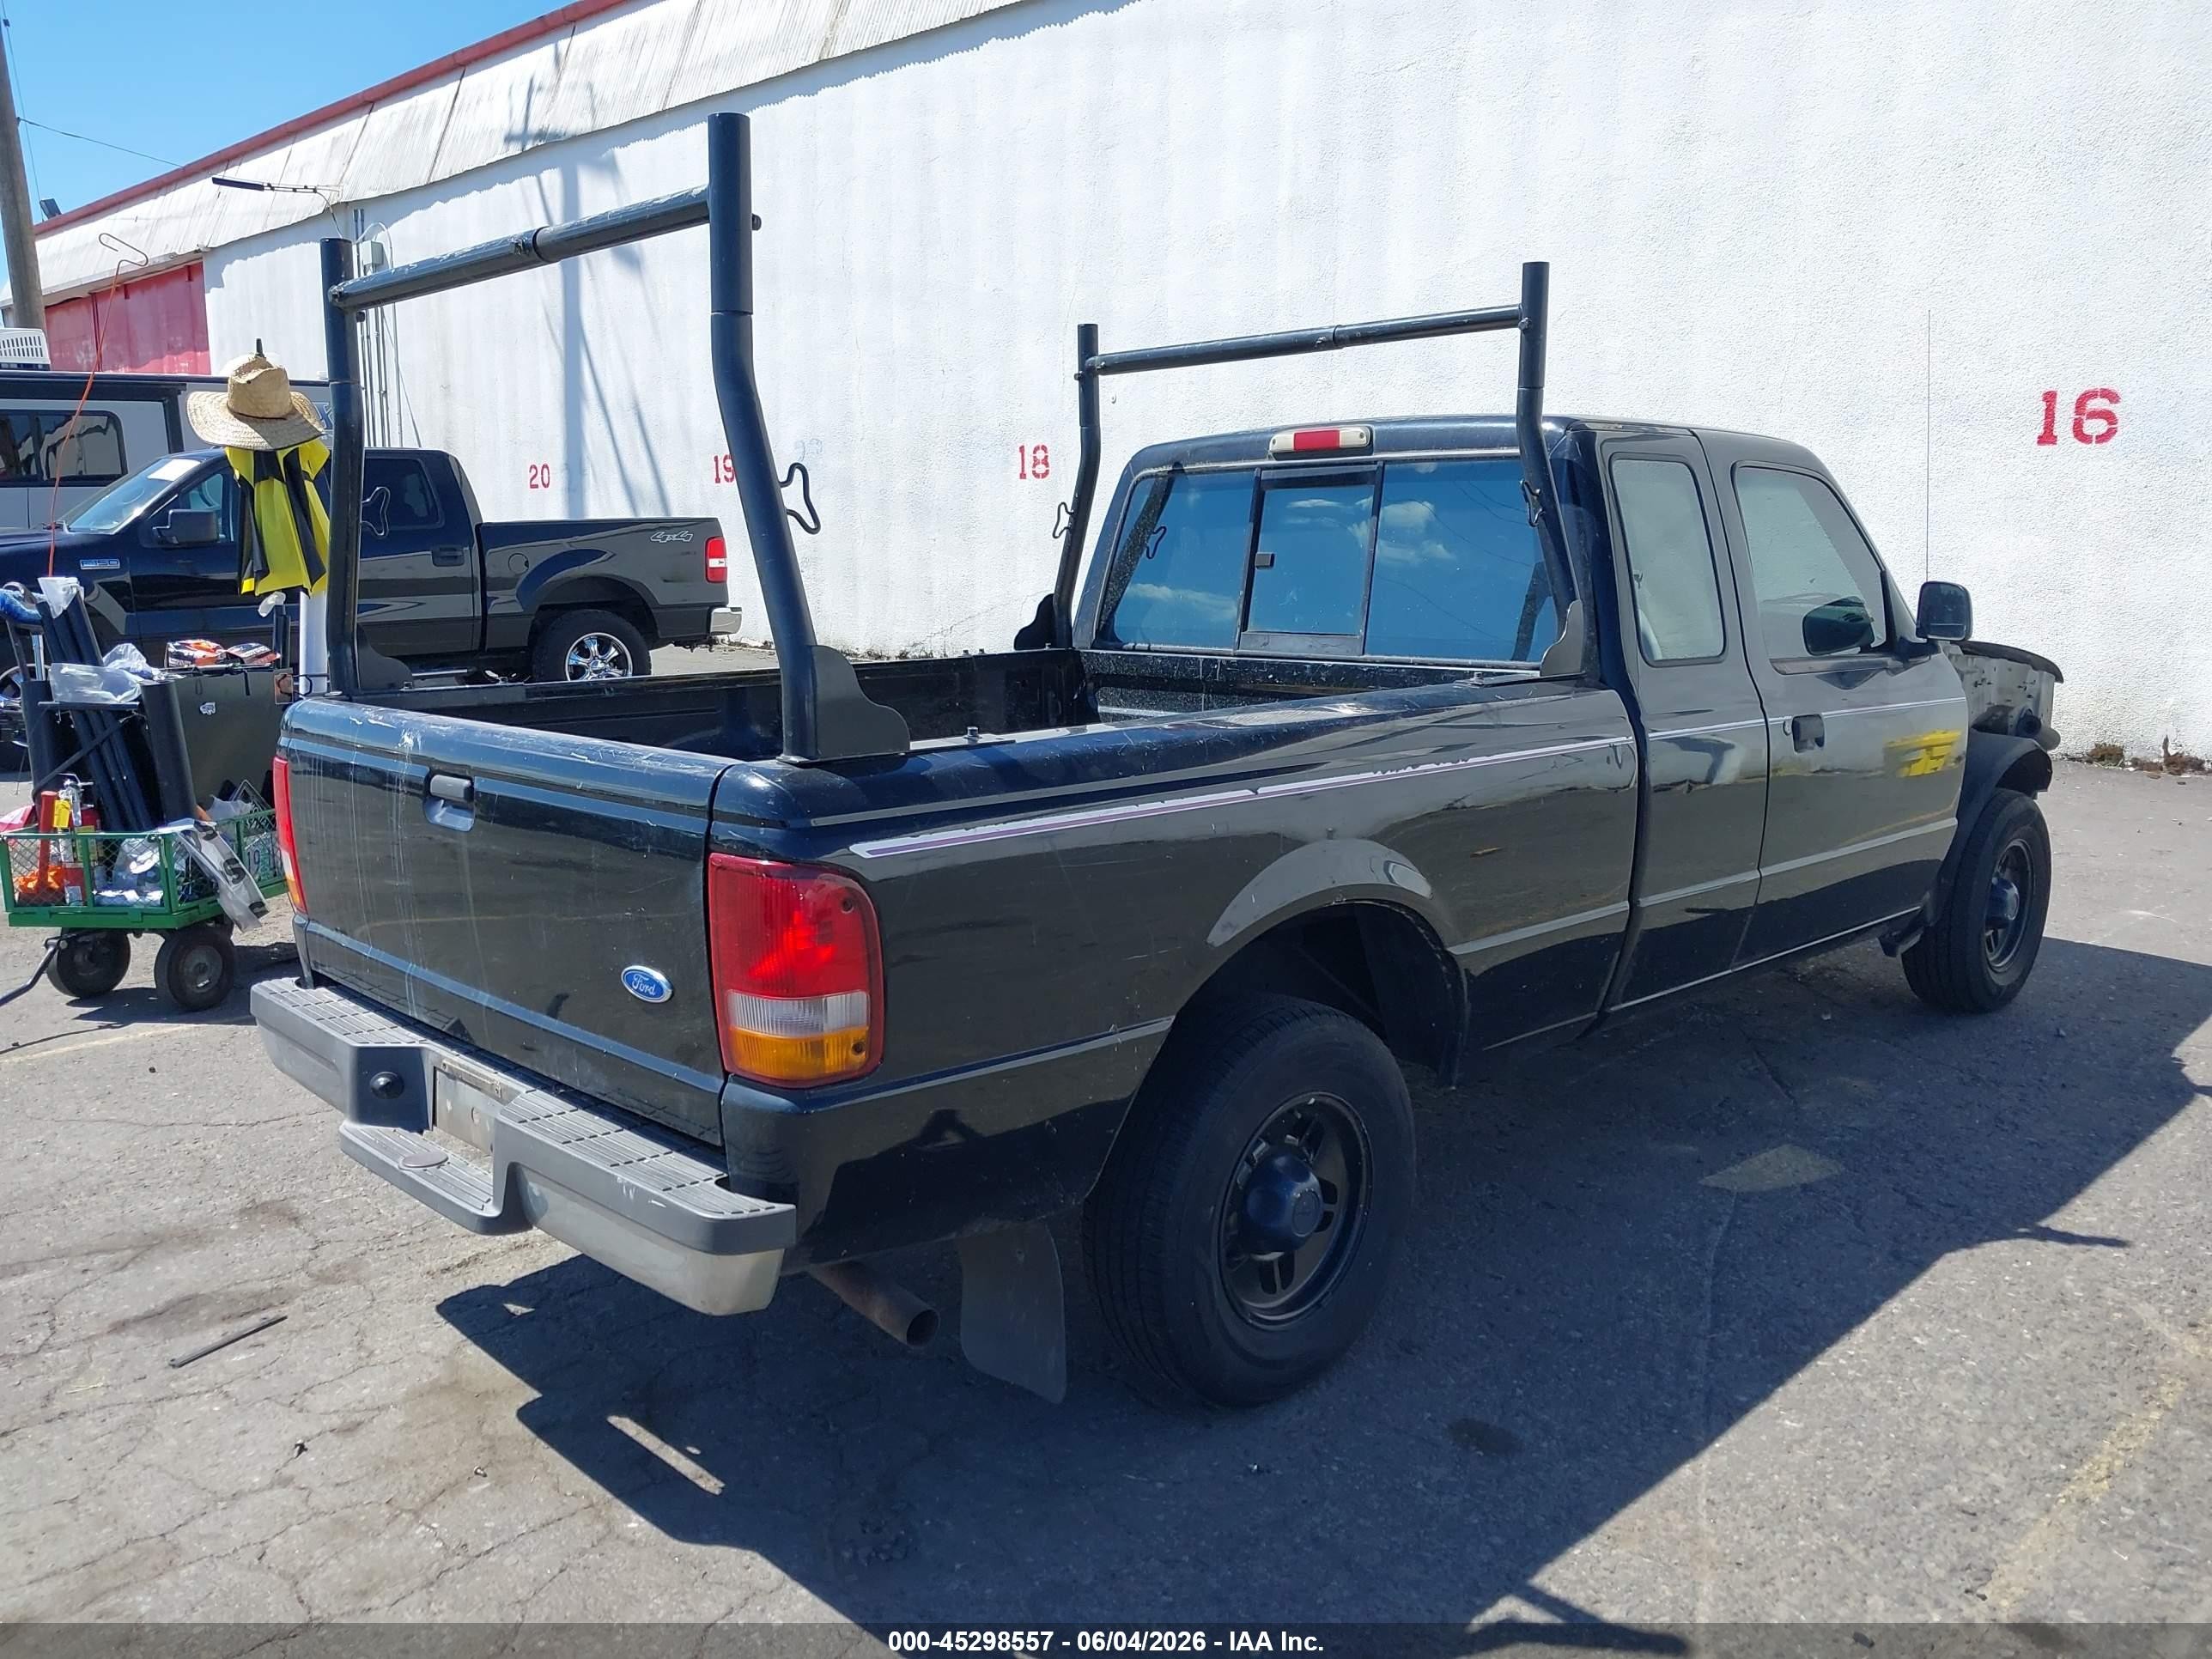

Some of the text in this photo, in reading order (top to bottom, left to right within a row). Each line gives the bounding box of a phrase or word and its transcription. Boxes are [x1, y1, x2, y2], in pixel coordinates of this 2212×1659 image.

[2036, 387, 2121, 445] 16
[529, 463, 550, 489] 20
[714, 454, 736, 484] 19
[1018, 444, 1050, 480] 18
[632, 973, 656, 996] Ford
